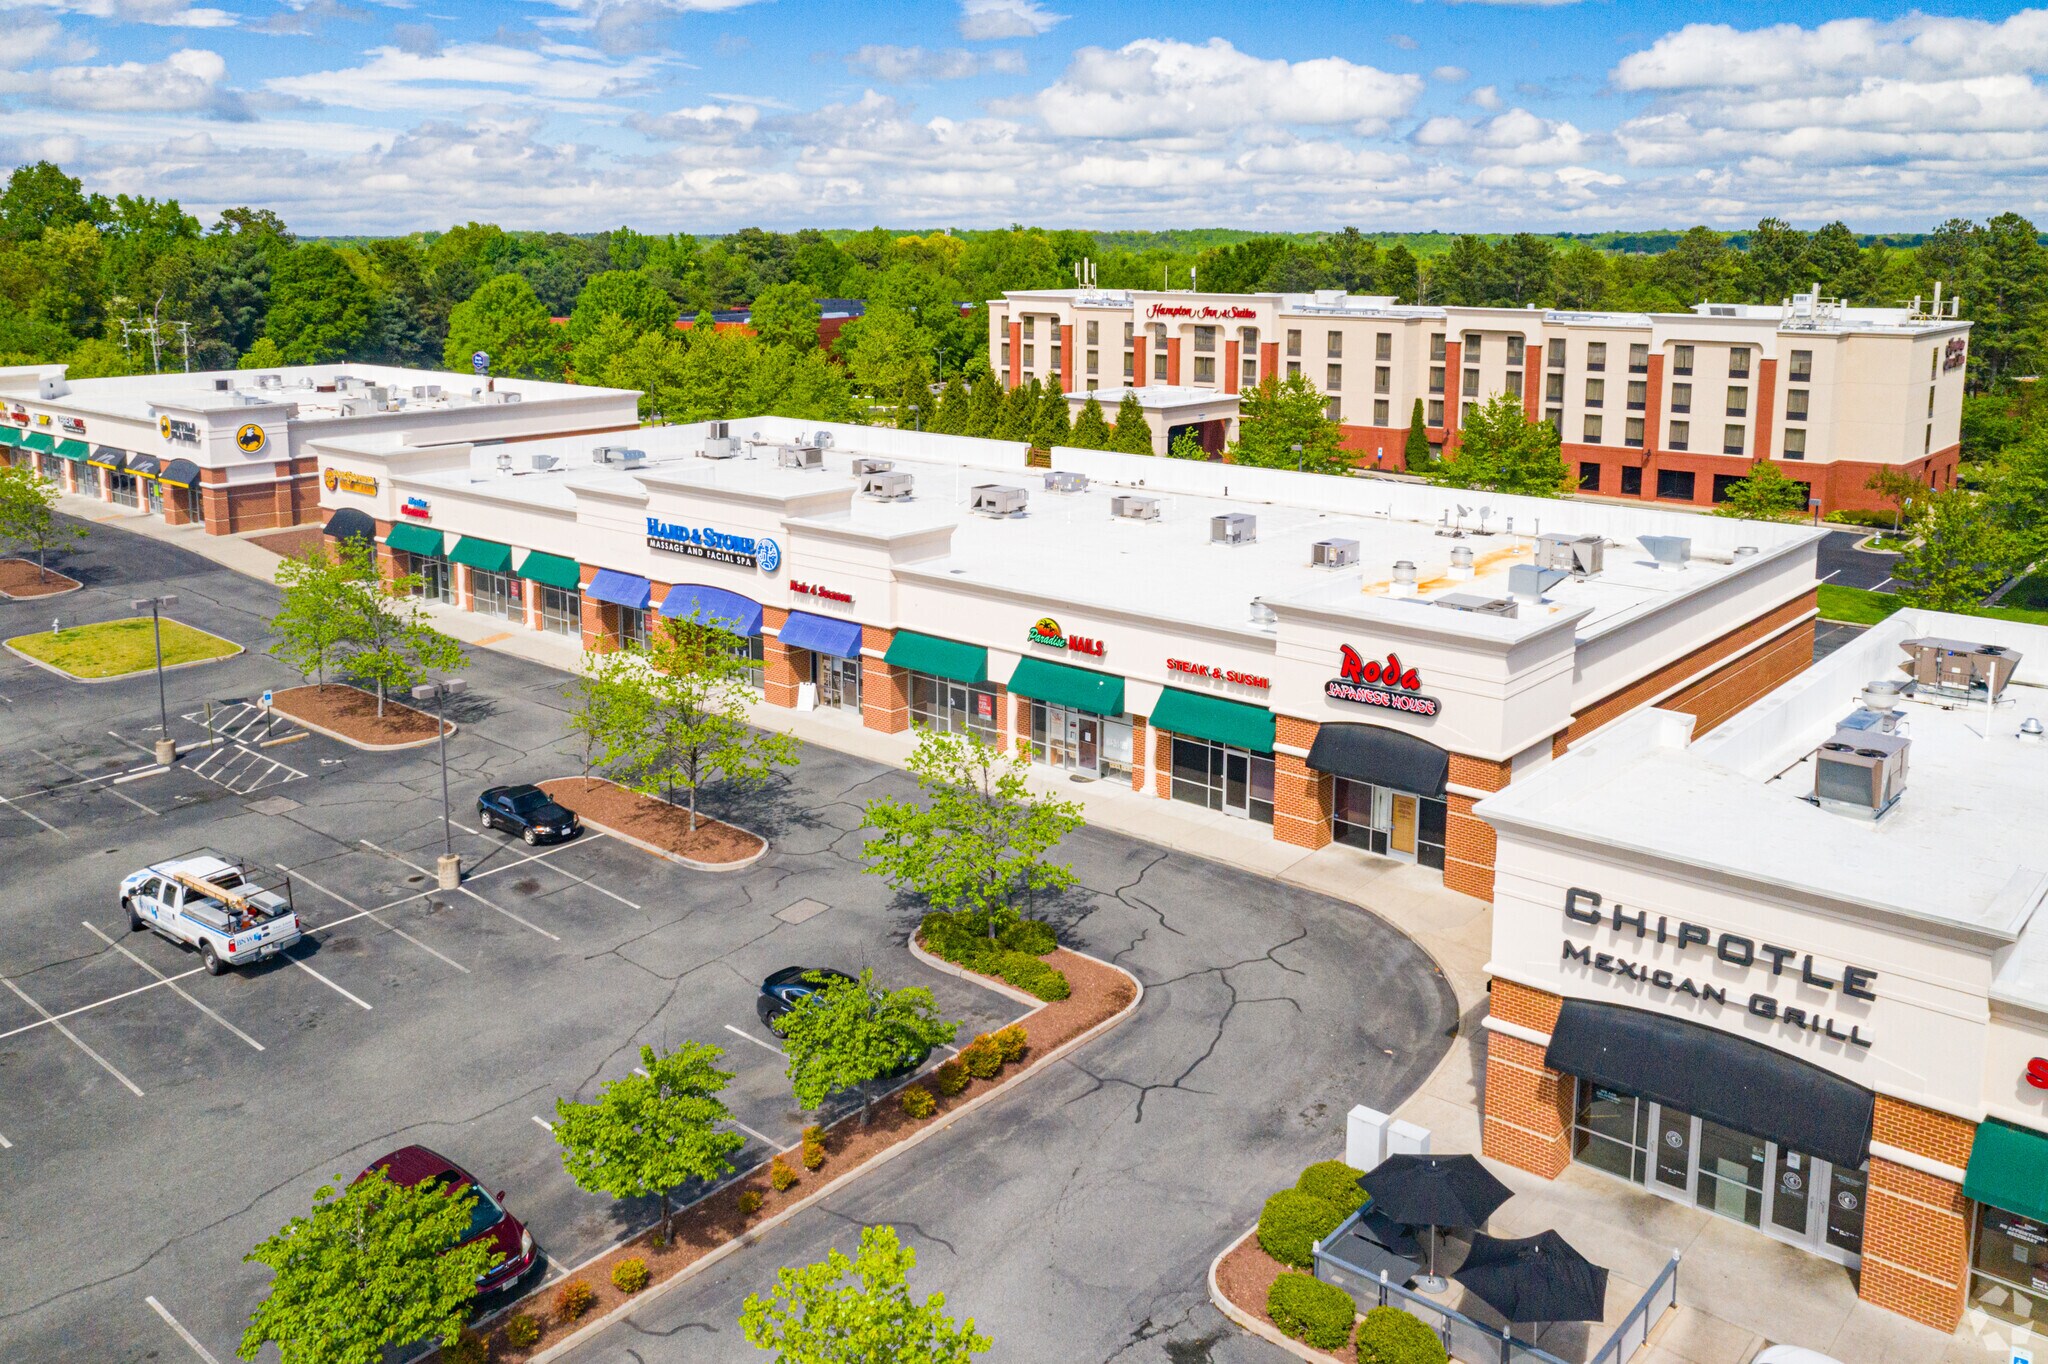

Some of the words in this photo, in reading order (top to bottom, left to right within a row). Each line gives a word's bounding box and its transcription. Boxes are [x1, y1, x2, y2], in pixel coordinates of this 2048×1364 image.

[1146, 303, 1197, 319] Hampton
[1197, 306, 1221, 320] Inn
[1228, 306, 1257, 320] Suites
[690, 527, 701, 543] &
[649, 539, 684, 554] MASSAGE
[687, 547, 704, 557] AND
[706, 550, 735, 563] FACIAL
[736, 555, 752, 567] SPA
[810, 584, 818, 596] 4
[1028, 627, 1067, 649] Paradise
[1068, 634, 1104, 657] NAILS
[1166, 658, 1209, 677] STEAK
[1212, 667, 1224, 680] &
[1226, 670, 1270, 690] SUSHI
[1340, 643, 1421, 691] Roda
[1327, 682, 1391, 706] JAPANESE
[1391, 693, 1436, 716] HOUSE
[1565, 886, 1878, 1002] CHIPOTLE
[1562, 939, 1727, 1006] MEXICAN
[1749, 993, 1873, 1048] GRILL
